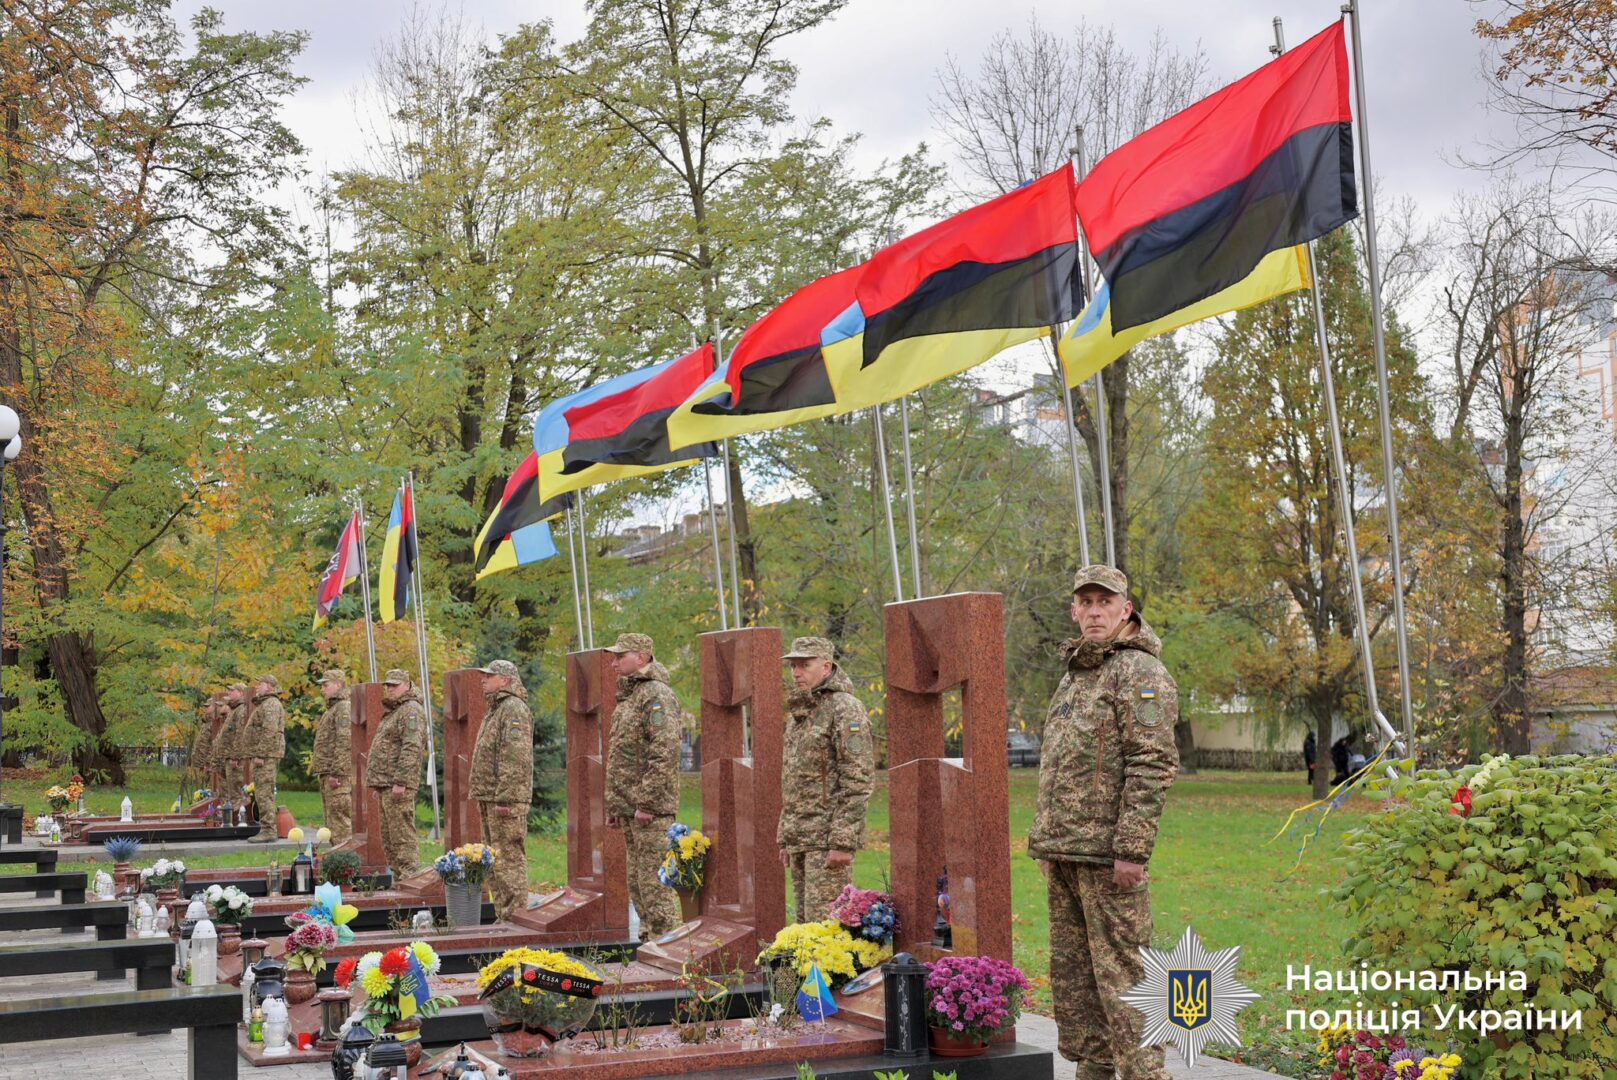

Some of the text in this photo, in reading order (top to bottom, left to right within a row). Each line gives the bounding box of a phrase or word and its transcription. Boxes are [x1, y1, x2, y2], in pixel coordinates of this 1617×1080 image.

[494, 973, 512, 989] TESSA
[537, 973, 559, 984] TESSA
[573, 981, 590, 990] TESSA
